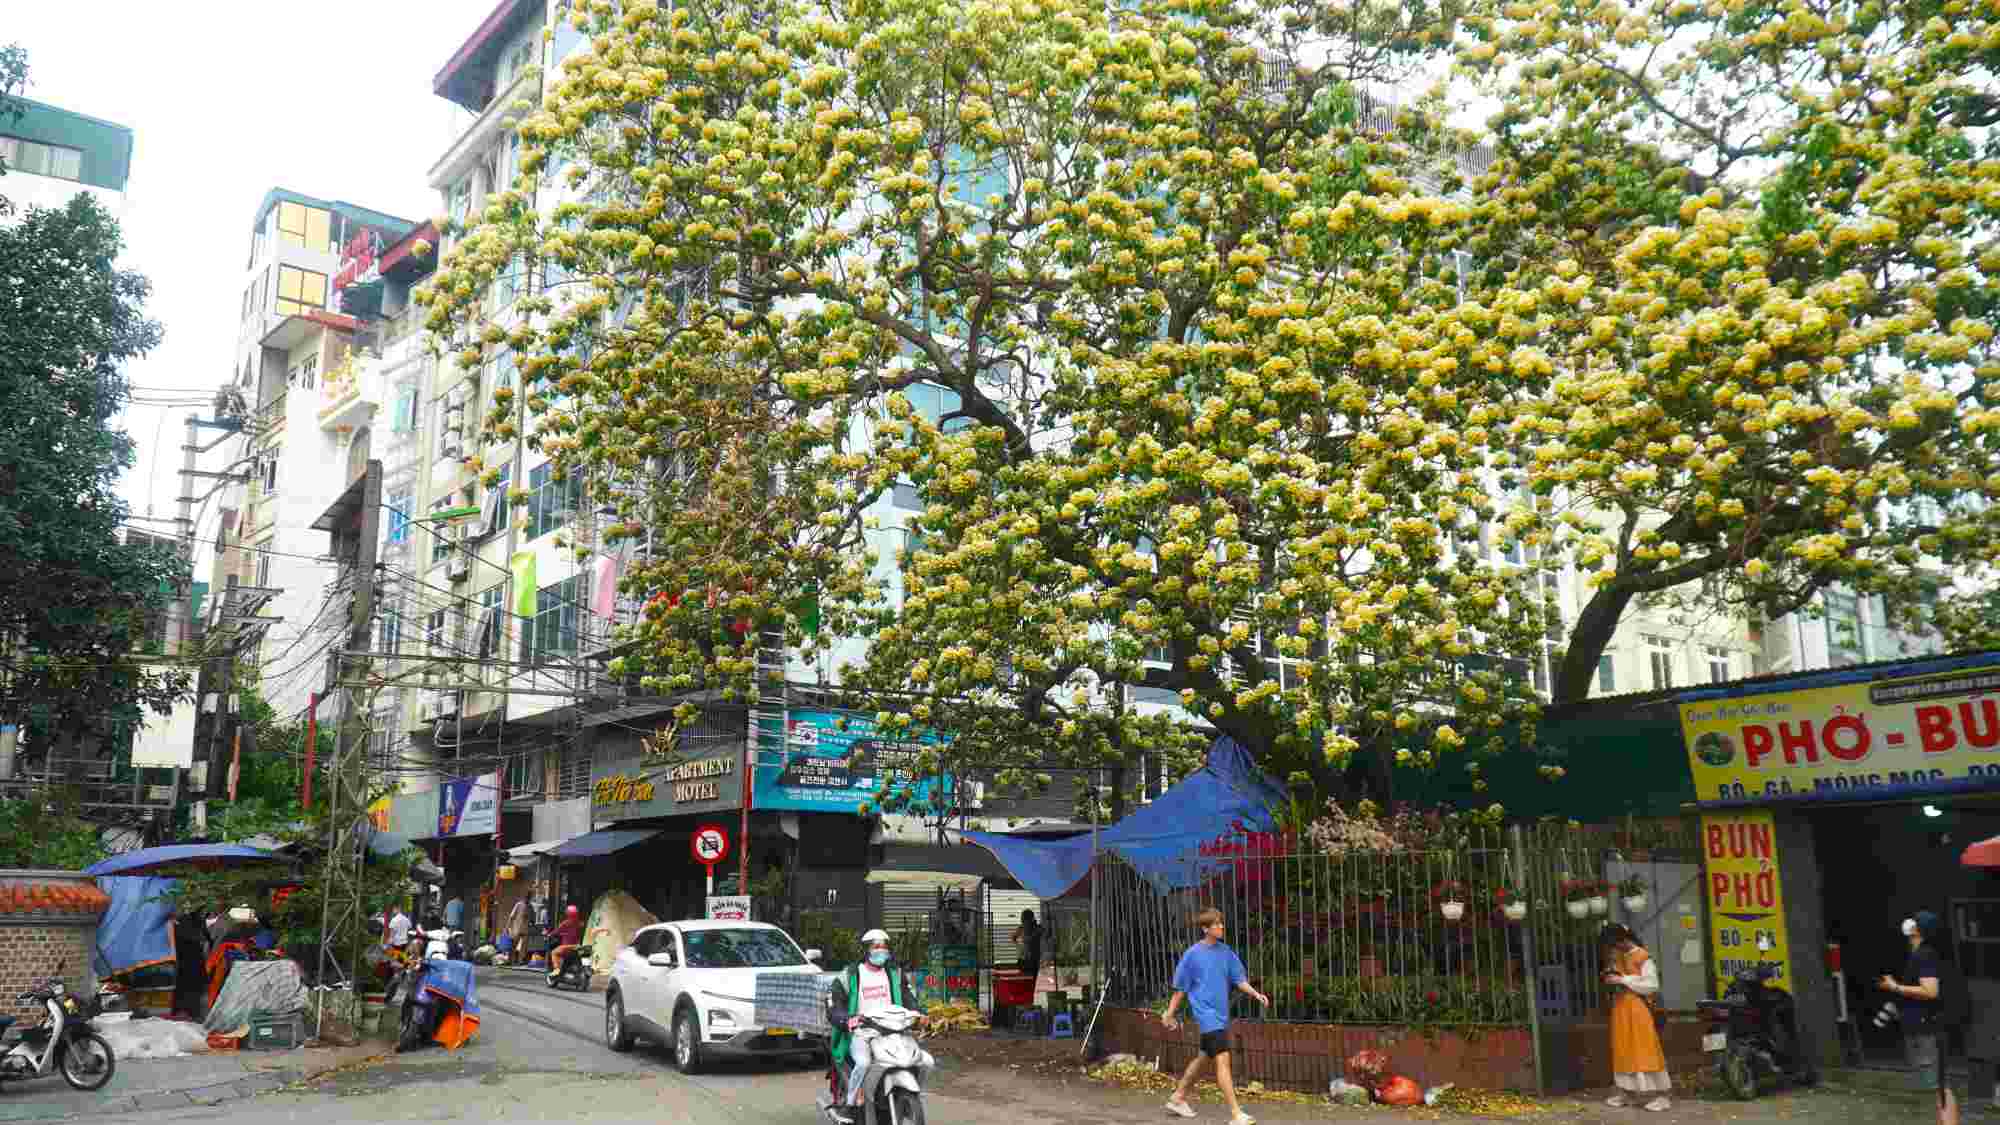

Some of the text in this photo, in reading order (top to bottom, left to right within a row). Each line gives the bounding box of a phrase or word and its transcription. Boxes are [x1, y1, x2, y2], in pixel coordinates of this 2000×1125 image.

[1741, 704, 1873, 767] PHỞ
[663, 758, 736, 783] APARTMENT
[675, 783, 717, 801] MOTEL
[1712, 861, 1776, 909] PHỞ
